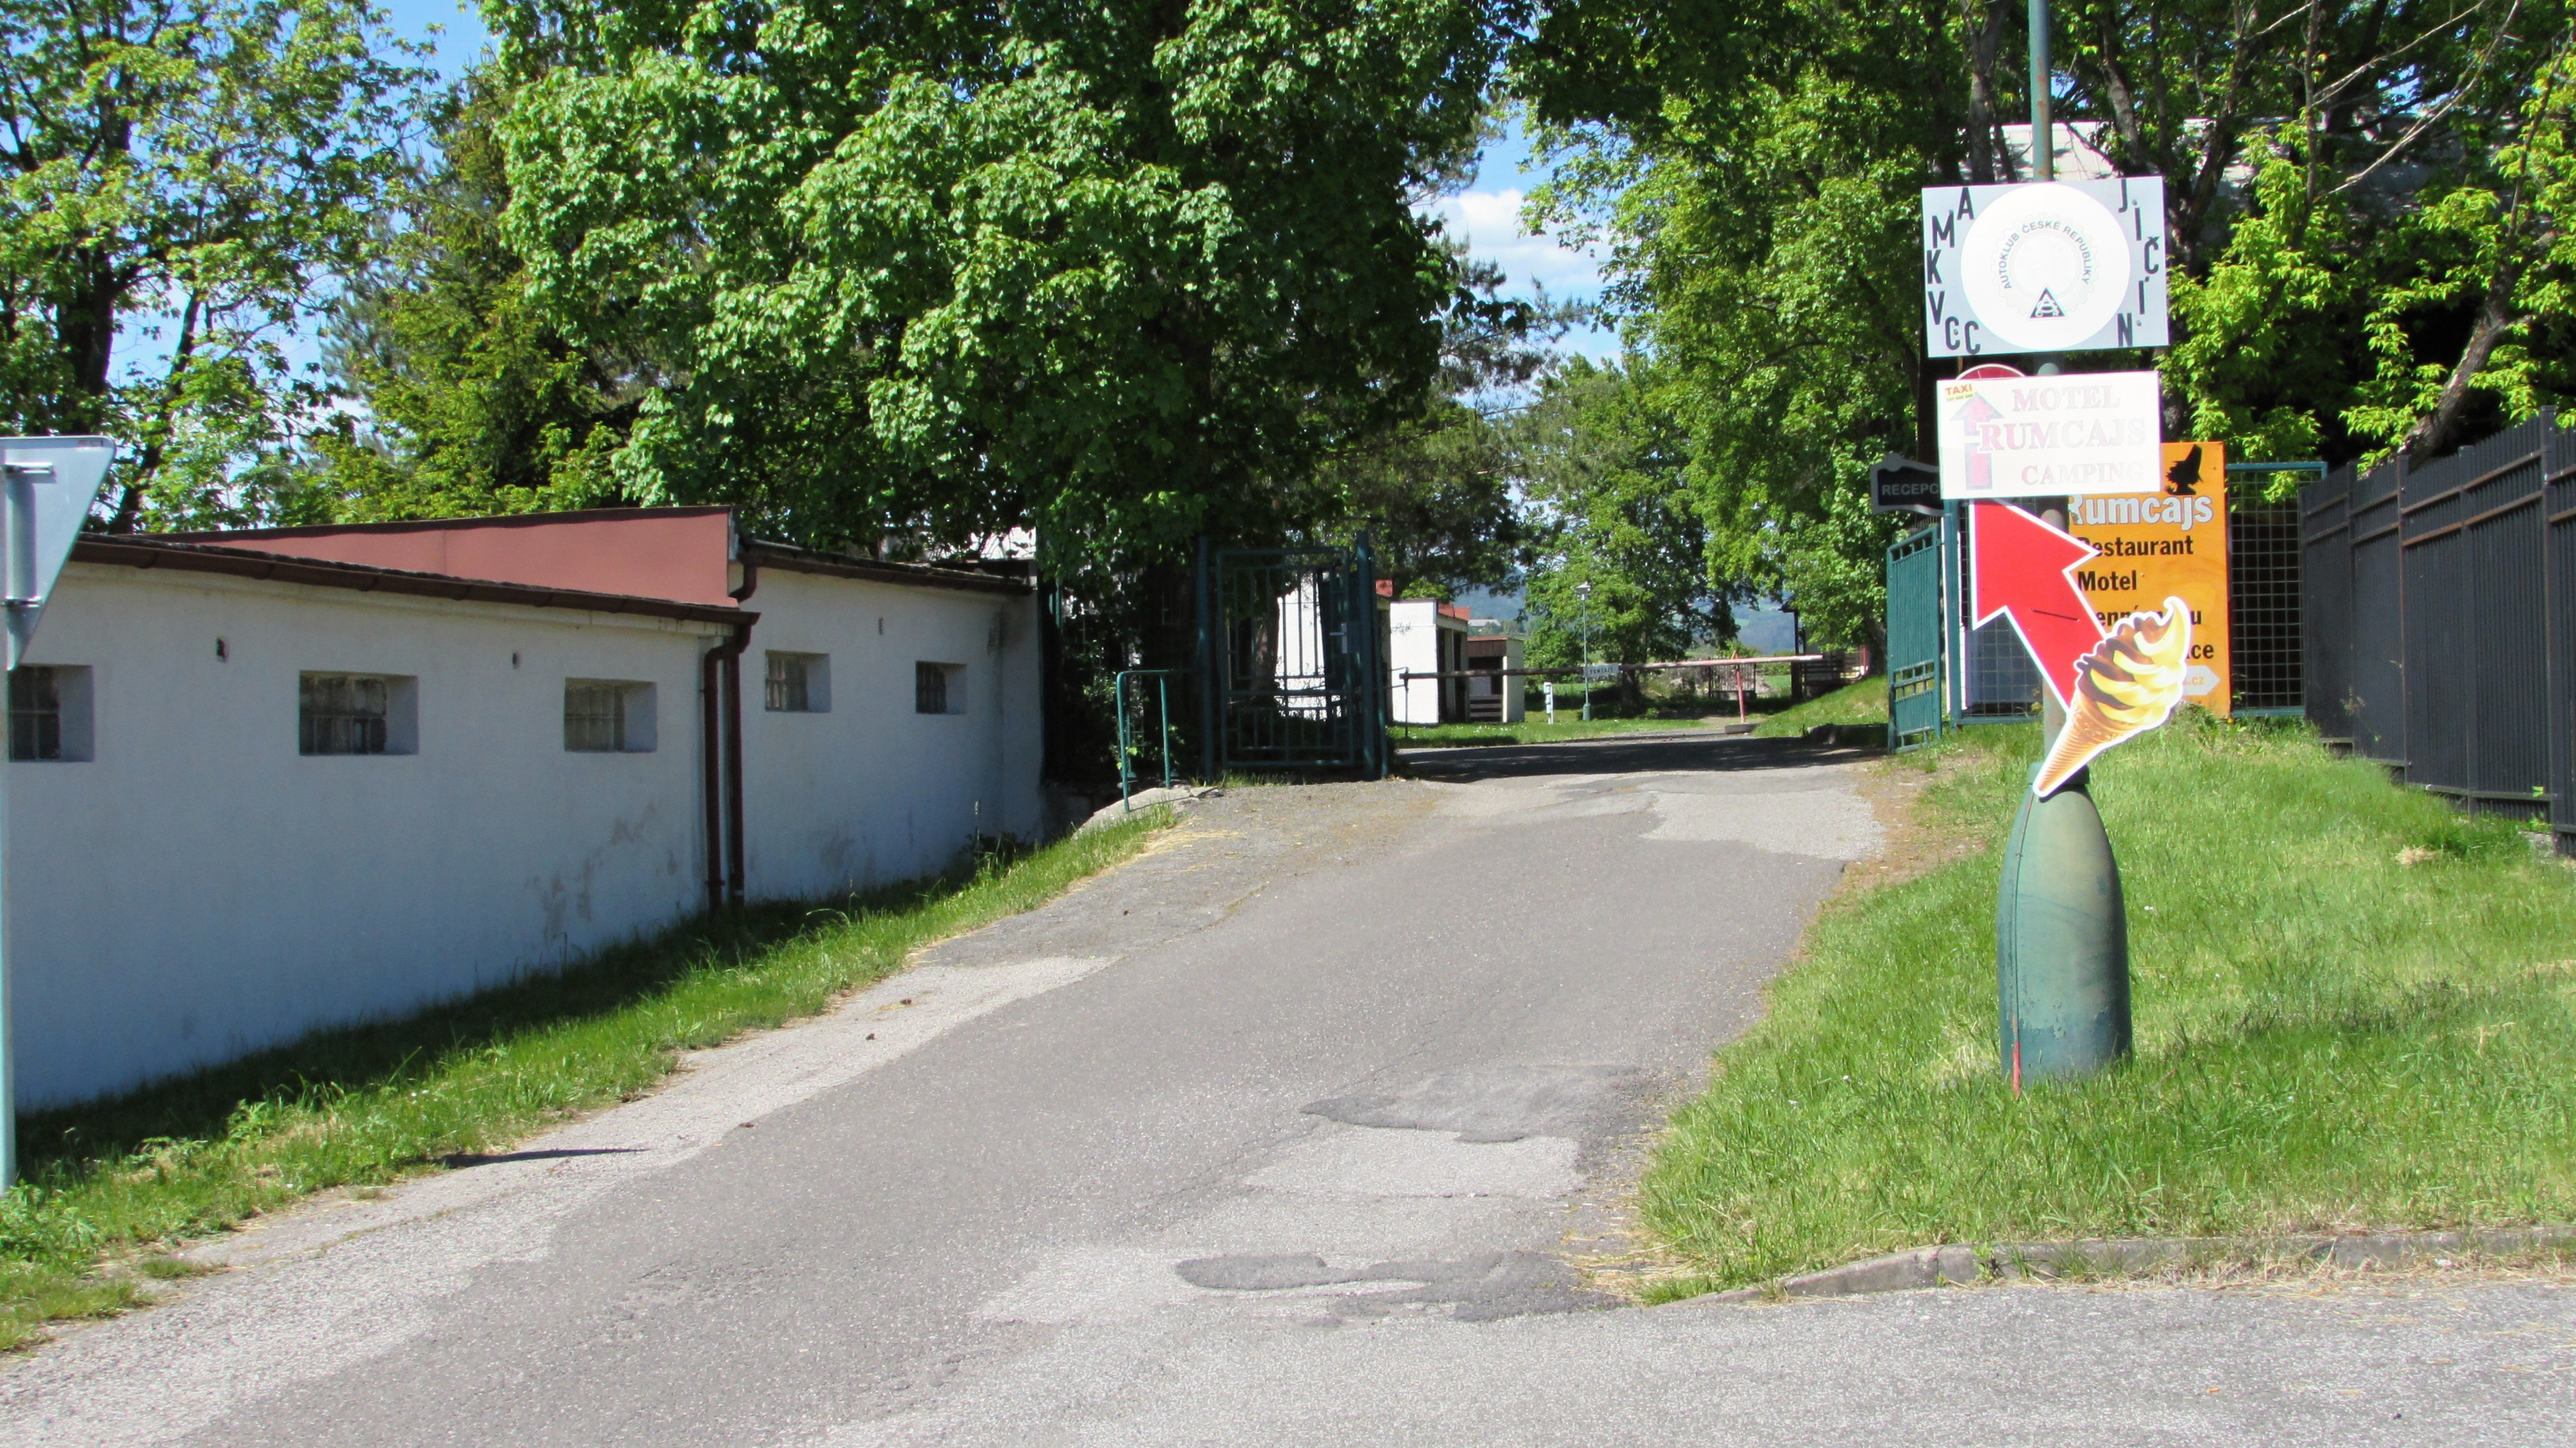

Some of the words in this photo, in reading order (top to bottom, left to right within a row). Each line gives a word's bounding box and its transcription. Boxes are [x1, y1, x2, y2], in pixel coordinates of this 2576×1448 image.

[1998, 233, 2020, 289] AUTOKLUB
[2022, 220, 2061, 234] ČESKÉ
[2063, 225, 2092, 285] REPUBLIKY
[1946, 383, 1973, 395] TAXI
[2011, 385, 2121, 412] MOTEL
[1979, 418, 2146, 452] RUMCAJS
[2021, 461, 2146, 486] CAMPING
[1882, 484, 1939, 495] RECEPC
[2078, 570, 2137, 591] Motel
